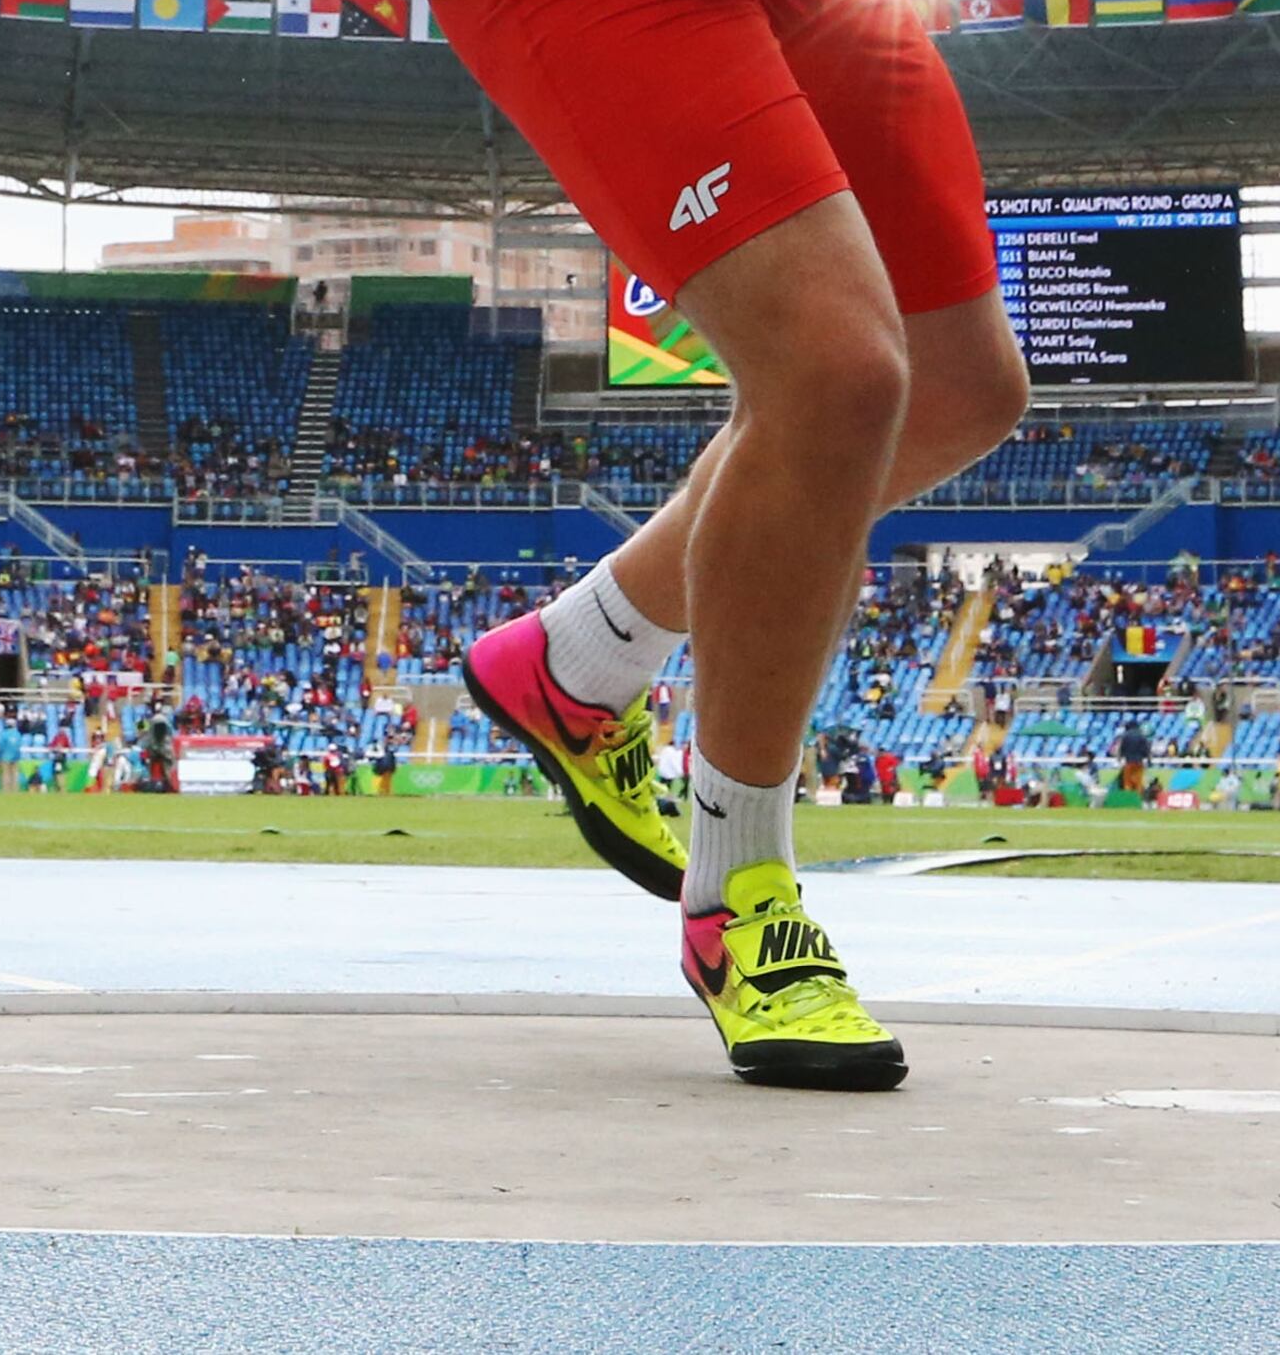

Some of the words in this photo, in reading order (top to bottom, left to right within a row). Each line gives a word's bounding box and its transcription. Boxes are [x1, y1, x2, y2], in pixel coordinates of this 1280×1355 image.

[669, 162, 731, 232] 4F
[1000, 199, 1029, 214] SHOT
[1031, 198, 1053, 213] PUT
[1062, 196, 1130, 212] QUALIFYING
[1131, 195, 1172, 211] ROUND
[1181, 194, 1222, 210] GROUP
[1223, 194, 1234, 208] A
[1027, 232, 1068, 245] DERELI
[1027, 250, 1057, 262] BIAN
[1028, 266, 1066, 279] DUCO
[1028, 283, 1090, 296] SAUNDERS
[1028, 300, 1102, 313] OKWELOGU
[1029, 317, 1070, 331] SURDU
[1030, 335, 1065, 348] VIART
[1030, 351, 1099, 365] GAMBETTA
[756, 921, 839, 968] NIKE
